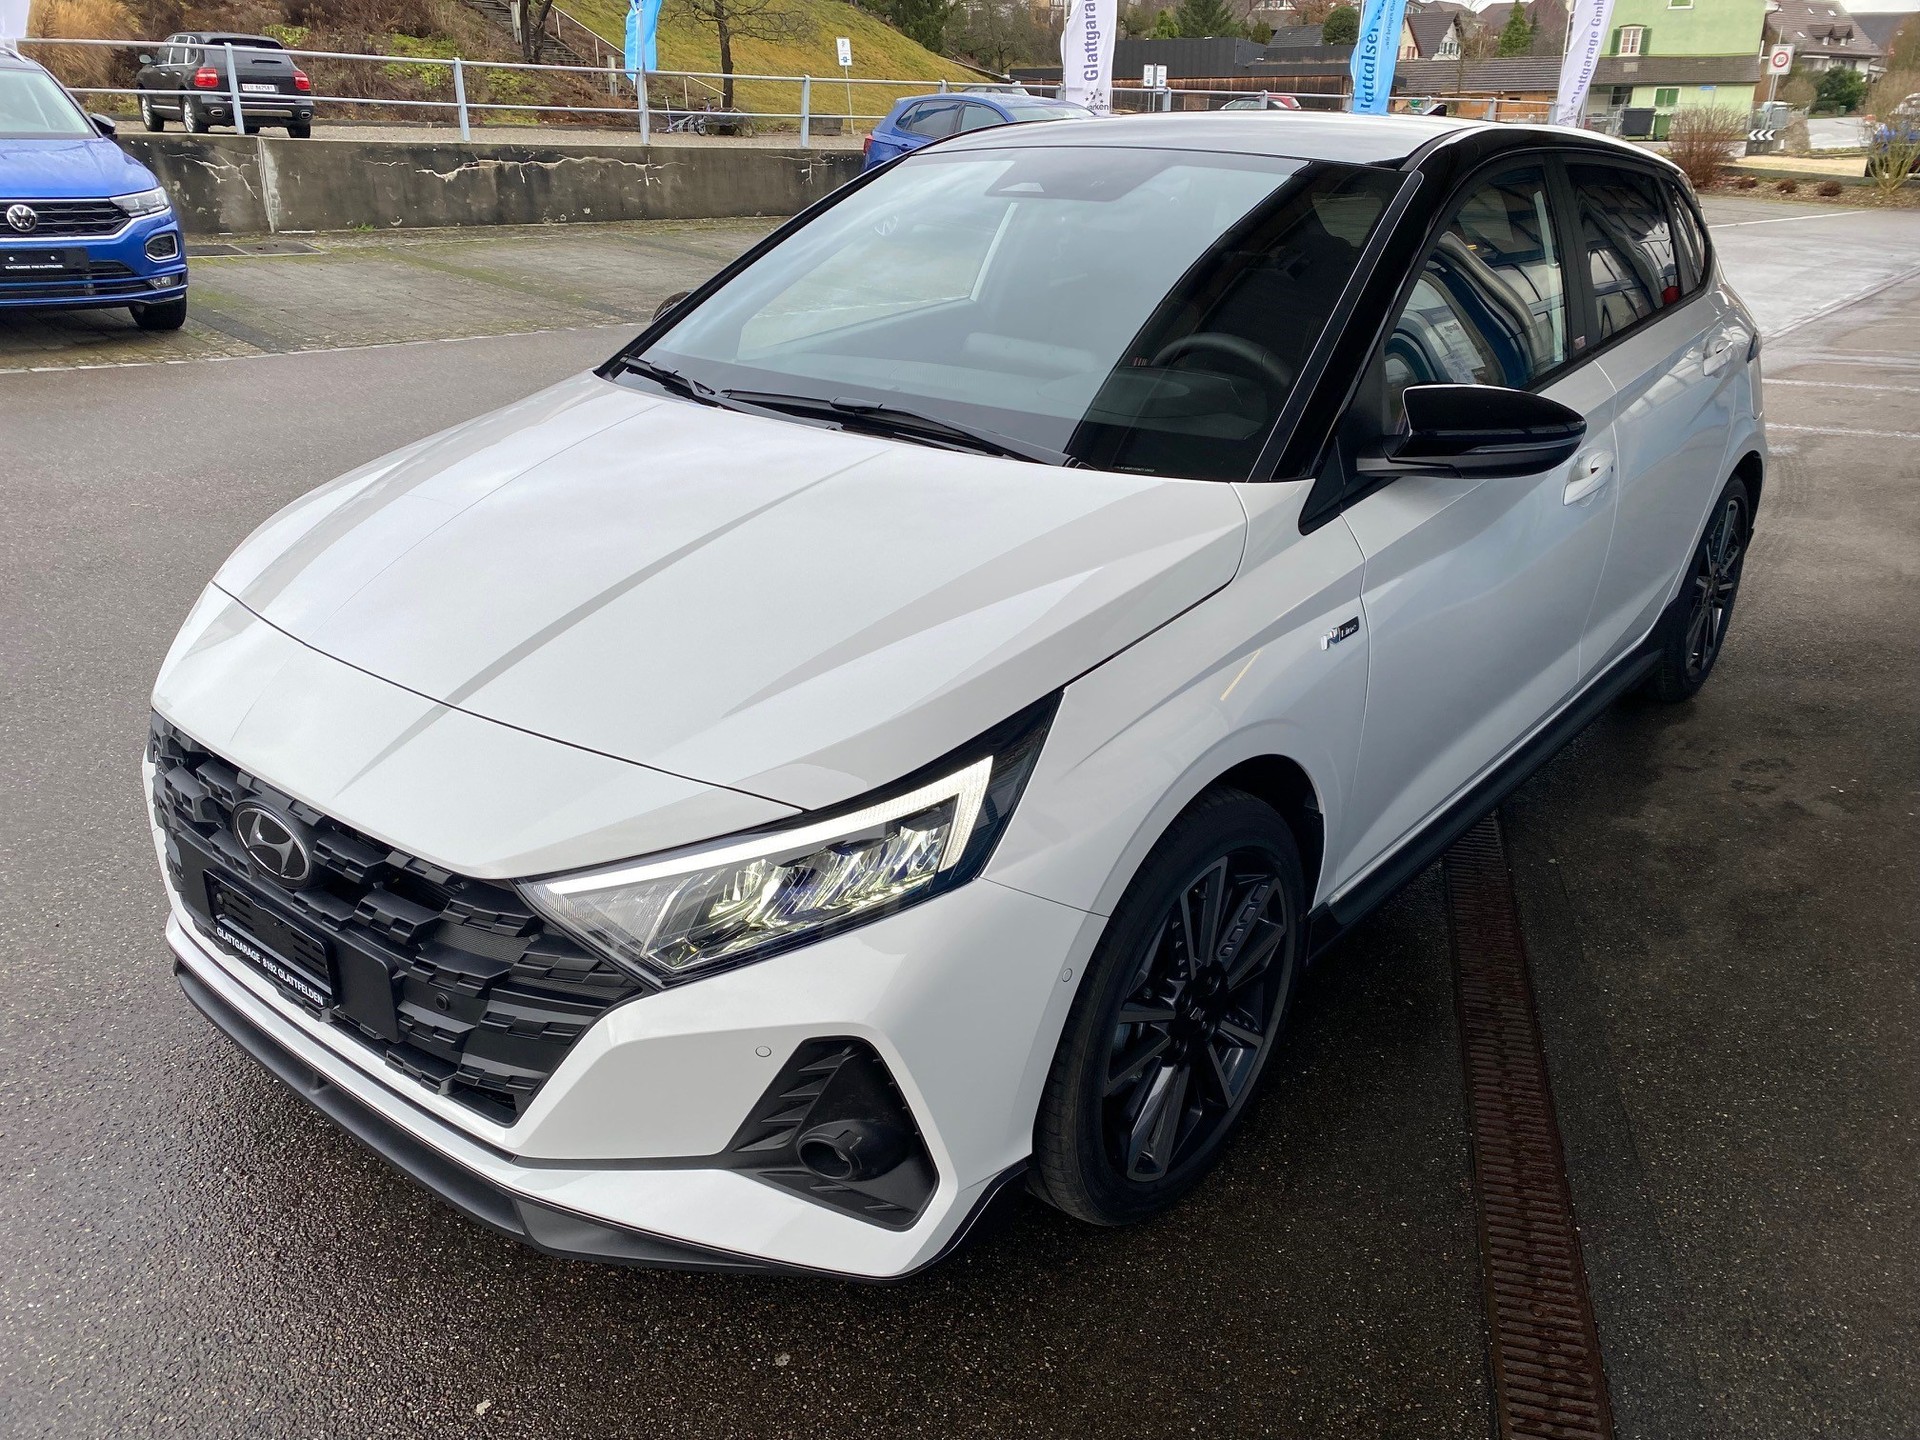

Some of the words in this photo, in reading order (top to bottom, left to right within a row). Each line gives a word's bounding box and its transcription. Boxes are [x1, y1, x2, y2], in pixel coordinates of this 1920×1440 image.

[1083, 0, 1101, 82] Glattgara
[216, 926, 261, 964] GLATTGARAGE
[262, 957, 278, 976] 8192
[277, 967, 325, 1006] GLATTFELDEN
